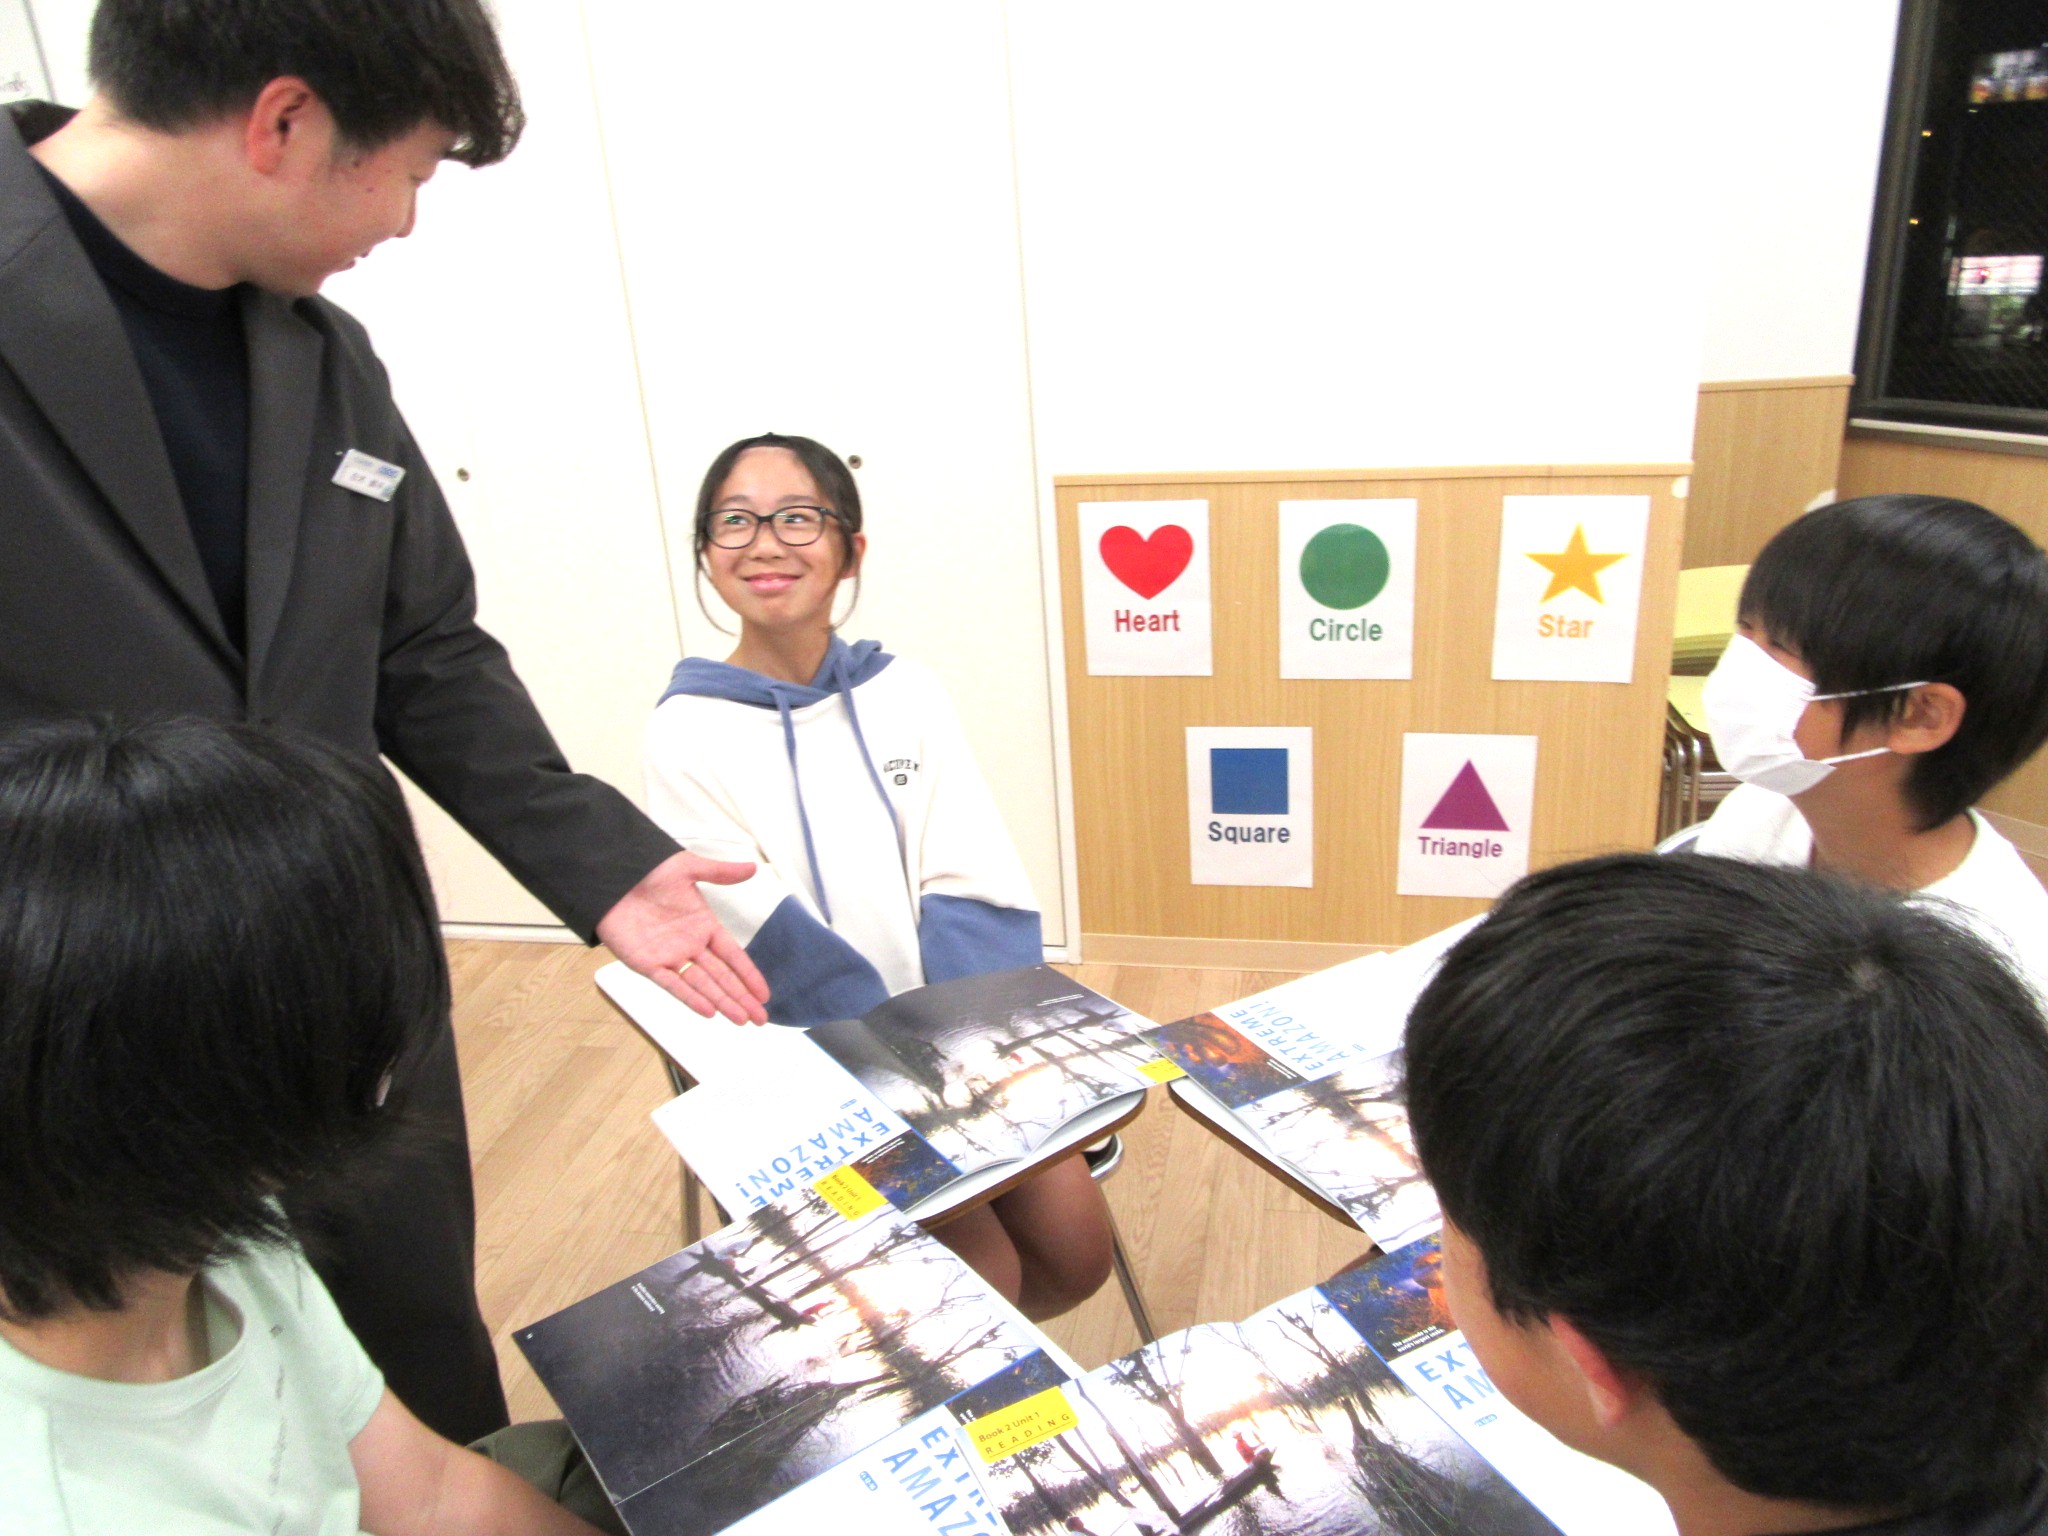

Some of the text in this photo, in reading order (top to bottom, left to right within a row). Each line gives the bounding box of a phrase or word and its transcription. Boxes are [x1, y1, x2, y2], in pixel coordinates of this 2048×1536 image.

[1115, 610, 1180, 632] Heart
[1310, 618, 1382, 641] Circle
[1539, 614, 1594, 638] Star
[1208, 821, 1290, 844] Square
[1418, 836, 1502, 858] Triangle
[1229, 1009, 1325, 1071] EXTREME
[1248, 1000, 1351, 1062] AMAZON!
[735, 1106, 873, 1198] AMAZON!
[750, 1121, 891, 1208] EXTREME
[978, 1427, 1004, 1443] Book
[1012, 1414, 1034, 1428] Unit
[985, 1413, 1070, 1455] READING
